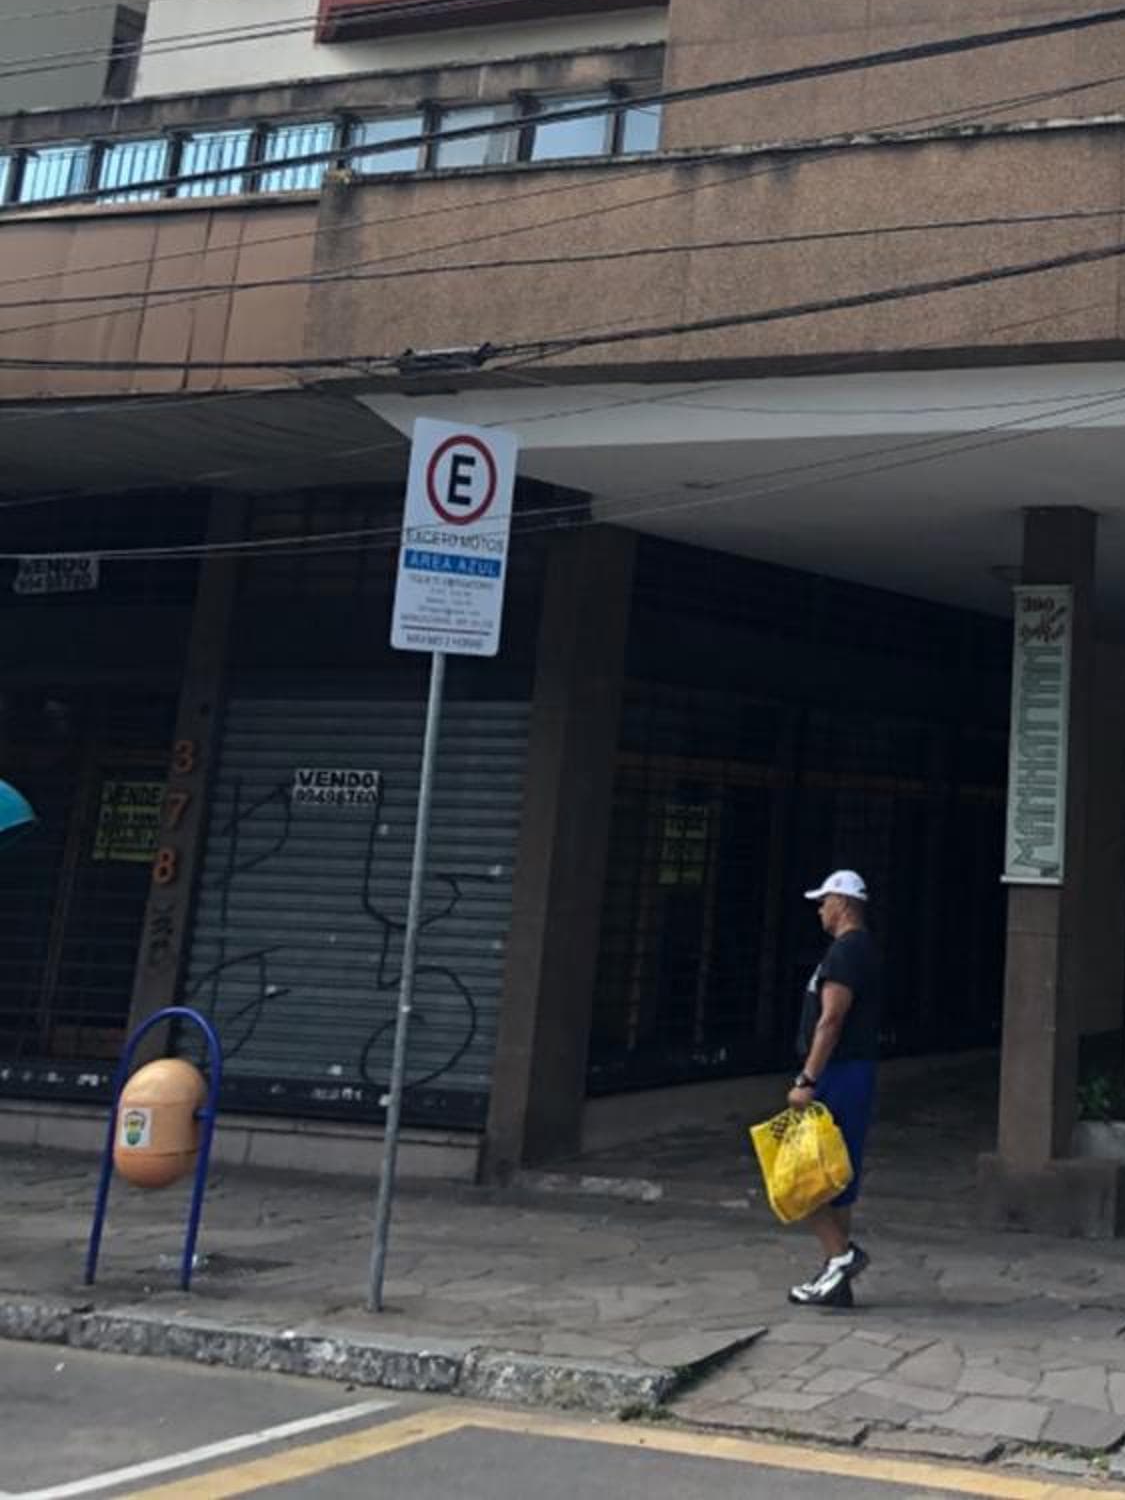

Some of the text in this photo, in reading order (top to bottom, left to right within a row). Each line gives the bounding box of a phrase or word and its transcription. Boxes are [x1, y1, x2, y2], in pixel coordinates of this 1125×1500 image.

[447, 454, 476, 506] E
[457, 558, 500, 577] AZUL
[298, 771, 375, 788] VENDO
